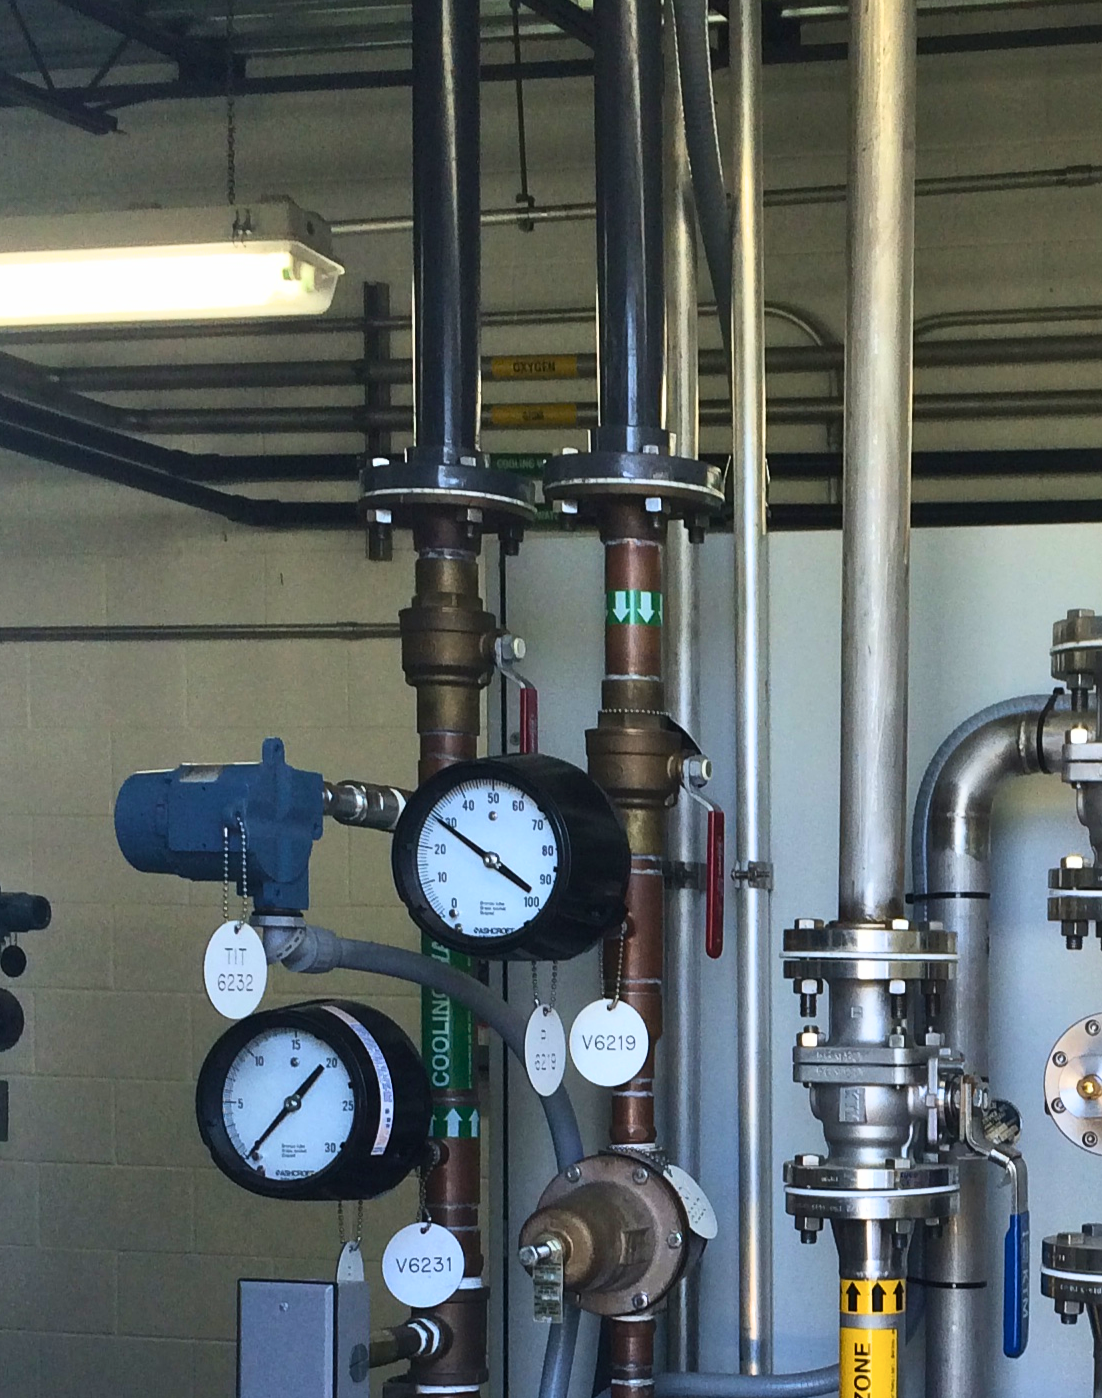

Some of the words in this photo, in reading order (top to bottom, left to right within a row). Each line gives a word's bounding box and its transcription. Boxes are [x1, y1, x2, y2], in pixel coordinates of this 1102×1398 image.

[512, 361, 556, 374] OXYGEN
[487, 792, 500, 804] 50
[462, 799, 475, 812] 40
[512, 800, 525, 812] 60
[532, 819, 544, 831] 70
[434, 844, 447, 855] 20
[541, 845, 554, 857] 80
[437, 872, 447, 883] 10
[539, 873, 552, 885] 90
[451, 897, 458, 909] 0
[523, 896, 540, 908] 100
[224, 947, 247, 966] TIT
[217, 973, 254, 992] 6232
[291, 1039, 301, 1050] 15
[582, 1034, 637, 1051] V6219
[255, 1055, 264, 1067] 10
[326, 1057, 338, 1069] 20
[237, 1098, 244, 1109] 5
[342, 1100, 354, 1112] 25
[324, 1142, 336, 1153] 30
[395, 1257, 452, 1273] V6231
